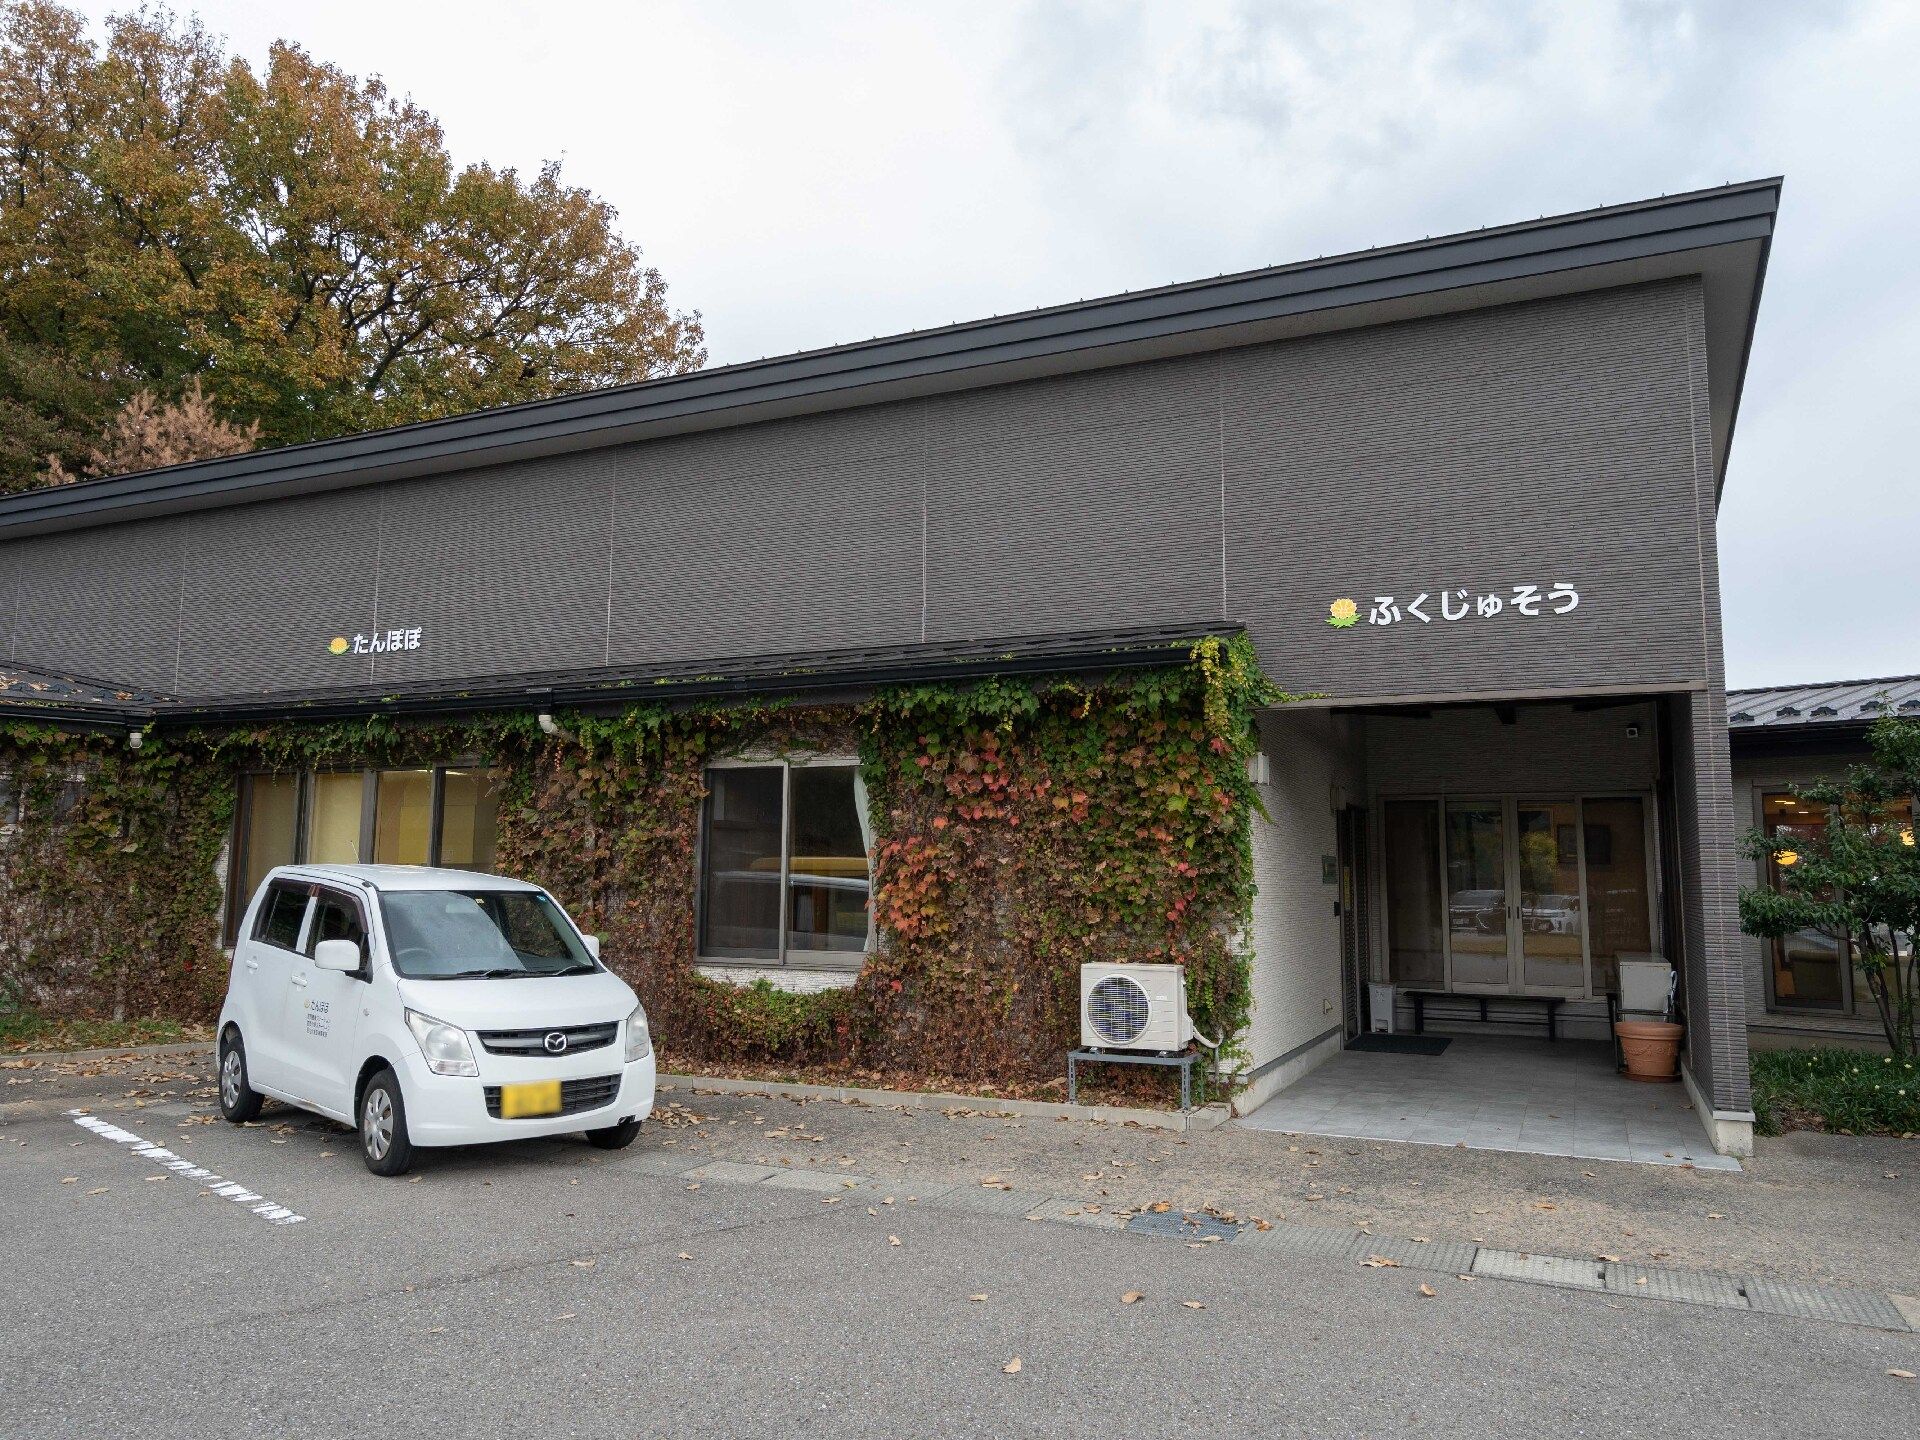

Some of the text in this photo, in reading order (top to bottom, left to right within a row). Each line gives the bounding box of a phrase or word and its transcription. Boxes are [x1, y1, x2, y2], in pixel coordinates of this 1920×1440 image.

[1368, 582, 1579, 626] ふくじゅそう
[353, 626, 423, 654] たんぽぽ
